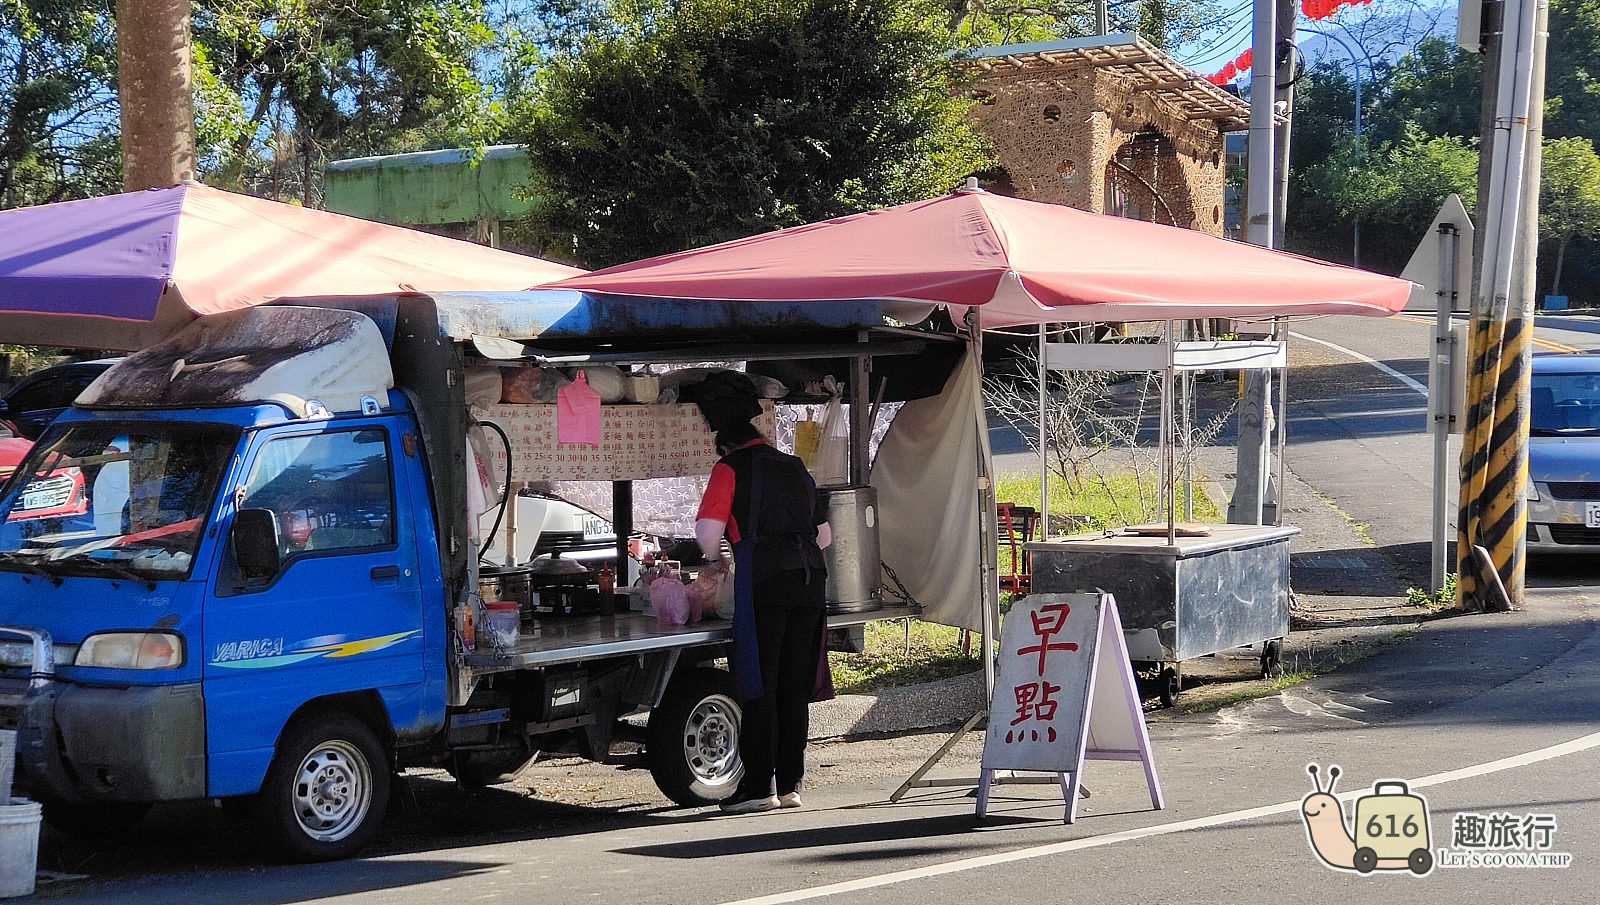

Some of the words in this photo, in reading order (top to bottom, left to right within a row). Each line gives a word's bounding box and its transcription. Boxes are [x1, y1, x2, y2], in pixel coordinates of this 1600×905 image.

[555, 454, 565, 462] 30
[567, 454, 577, 462] 30
[591, 454, 600, 462] 35
[602, 454, 612, 462] 35
[658, 453, 667, 461] 50
[670, 452, 679, 460] 55
[212, 637, 284, 662] VARICA
[1005, 603, 1079, 744] 早點
